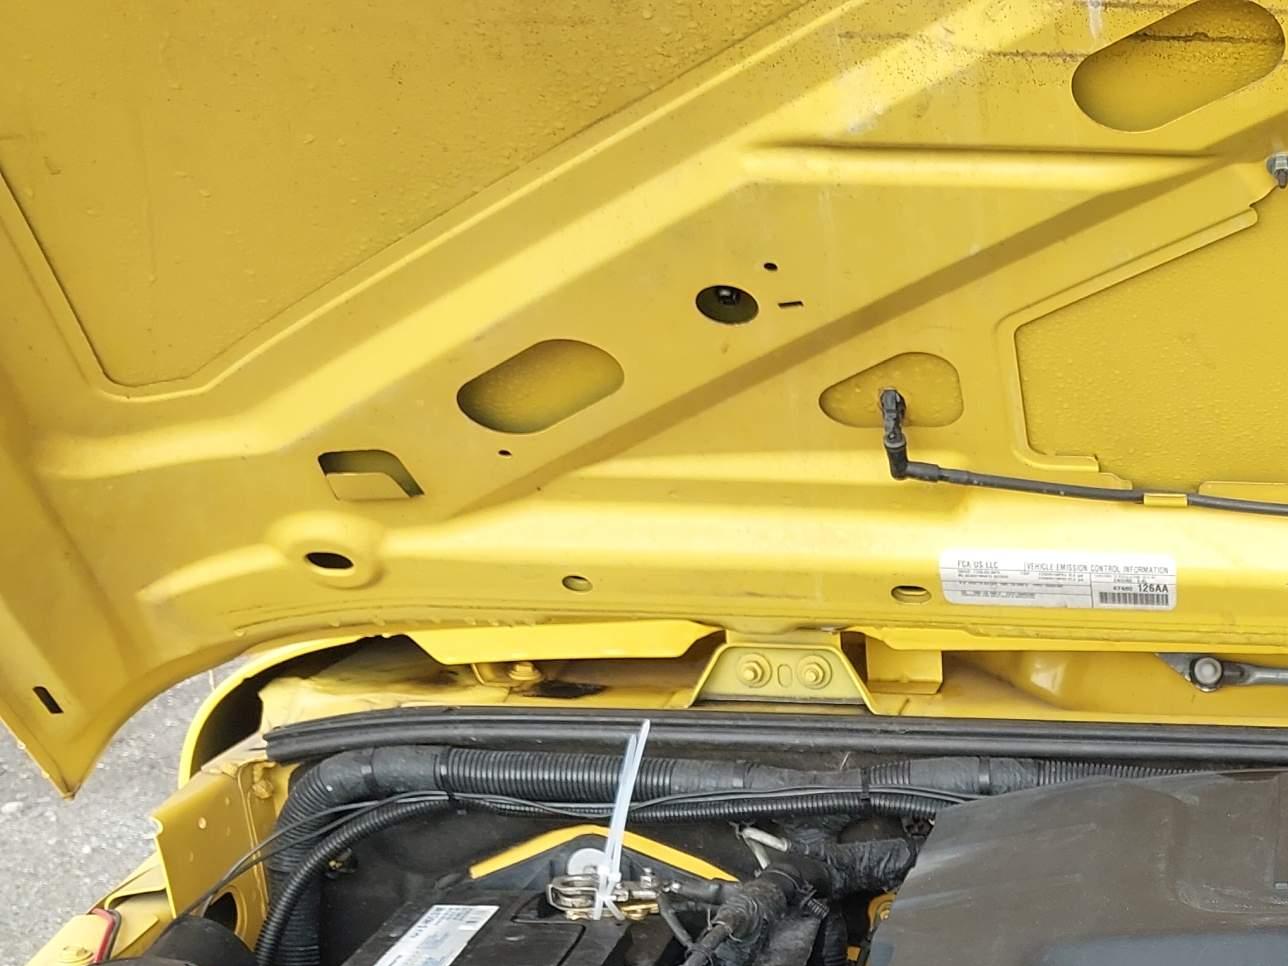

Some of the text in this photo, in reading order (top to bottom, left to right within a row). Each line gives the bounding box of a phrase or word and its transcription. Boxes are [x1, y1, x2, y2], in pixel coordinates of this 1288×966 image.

[1026, 562, 1169, 574] VEHICLE EMISSION CONTROL INFORMATION
[1138, 584, 1169, 593] 126AA
